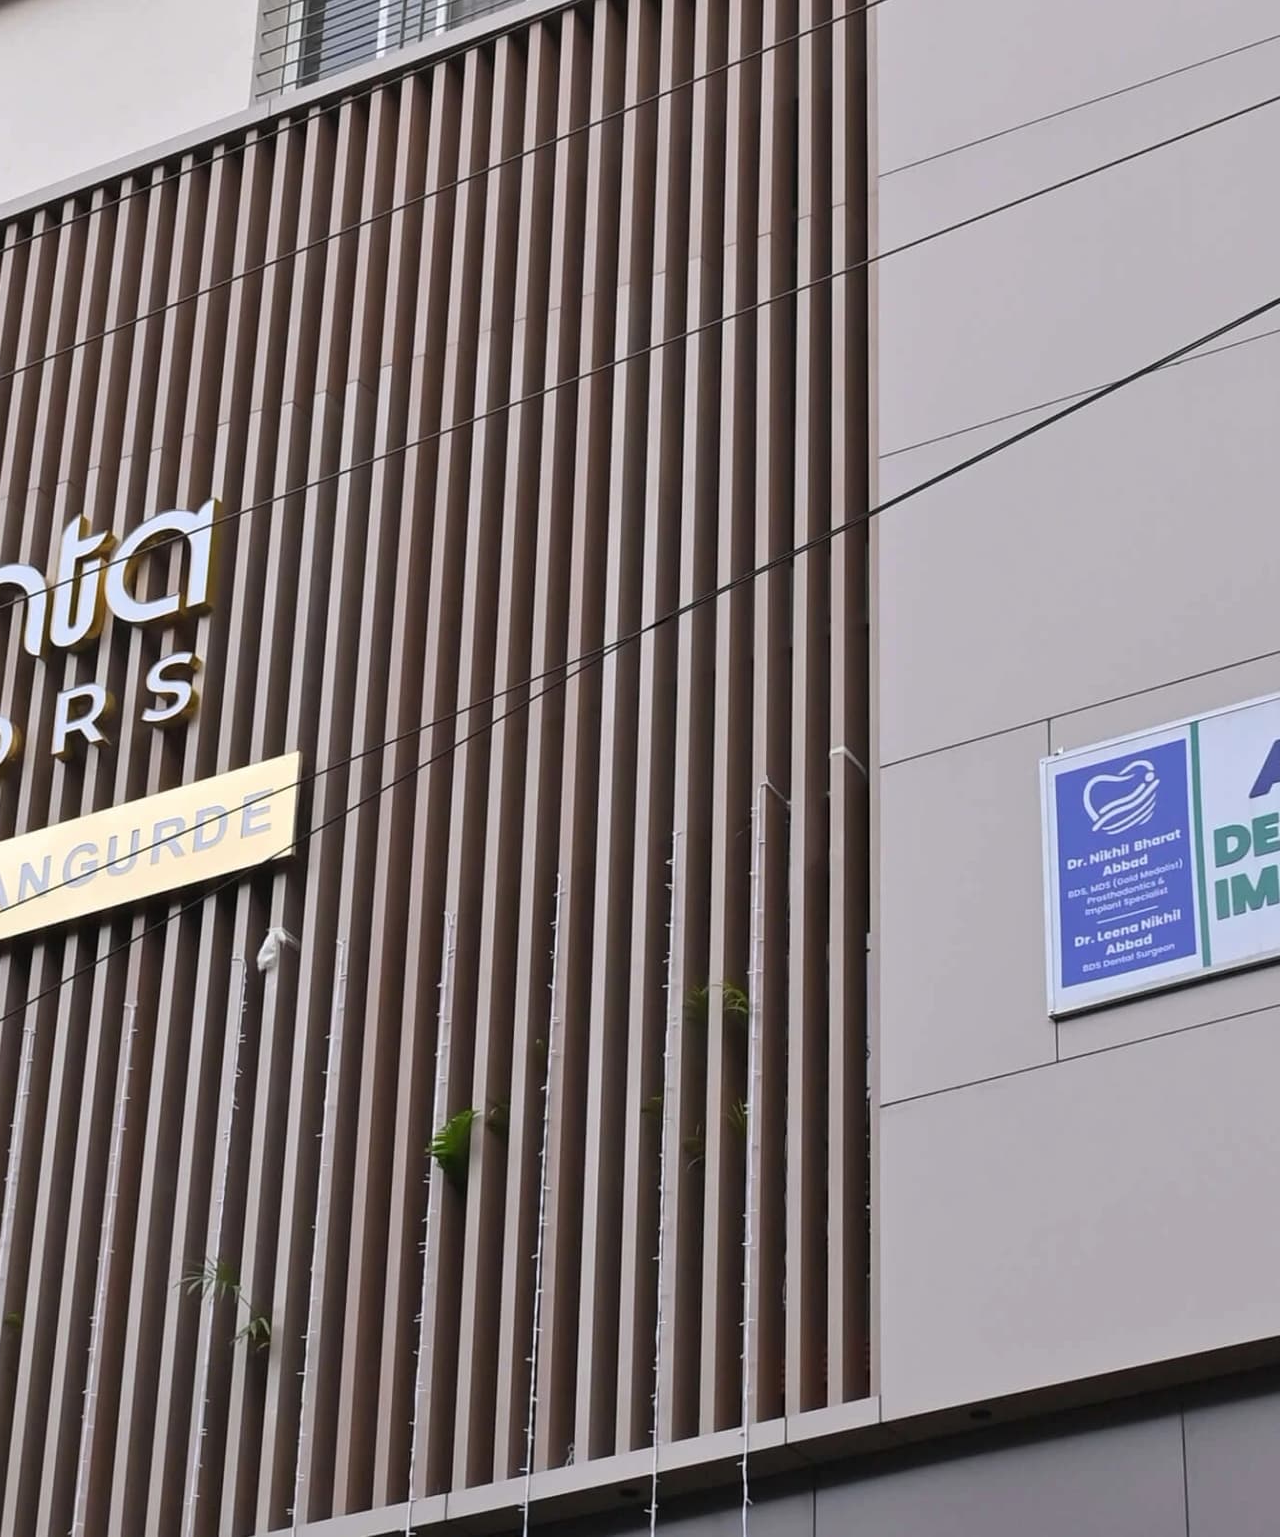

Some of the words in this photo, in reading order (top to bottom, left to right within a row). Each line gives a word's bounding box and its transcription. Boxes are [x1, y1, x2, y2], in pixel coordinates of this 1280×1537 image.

[1066, 857, 1088, 870] Dr.
[1089, 844, 1130, 865] Nikhil
[1133, 828, 1181, 852] Bharat
[1102, 854, 1149, 877] Abbad
[1084, 900, 1122, 917] Implant
[1123, 886, 1169, 908] Specialist
[1090, 880, 1111, 893] MDS
[1074, 934, 1095, 948] Dr.
[1096, 923, 1139, 942] Leena
[1140, 909, 1181, 931] Nikhil
[1081, 963, 1102, 973] BDS
[1103, 953, 1135, 968] Dental
[1135, 942, 1176, 961] Surgeon
[1105, 933, 1152, 956] Abbad
